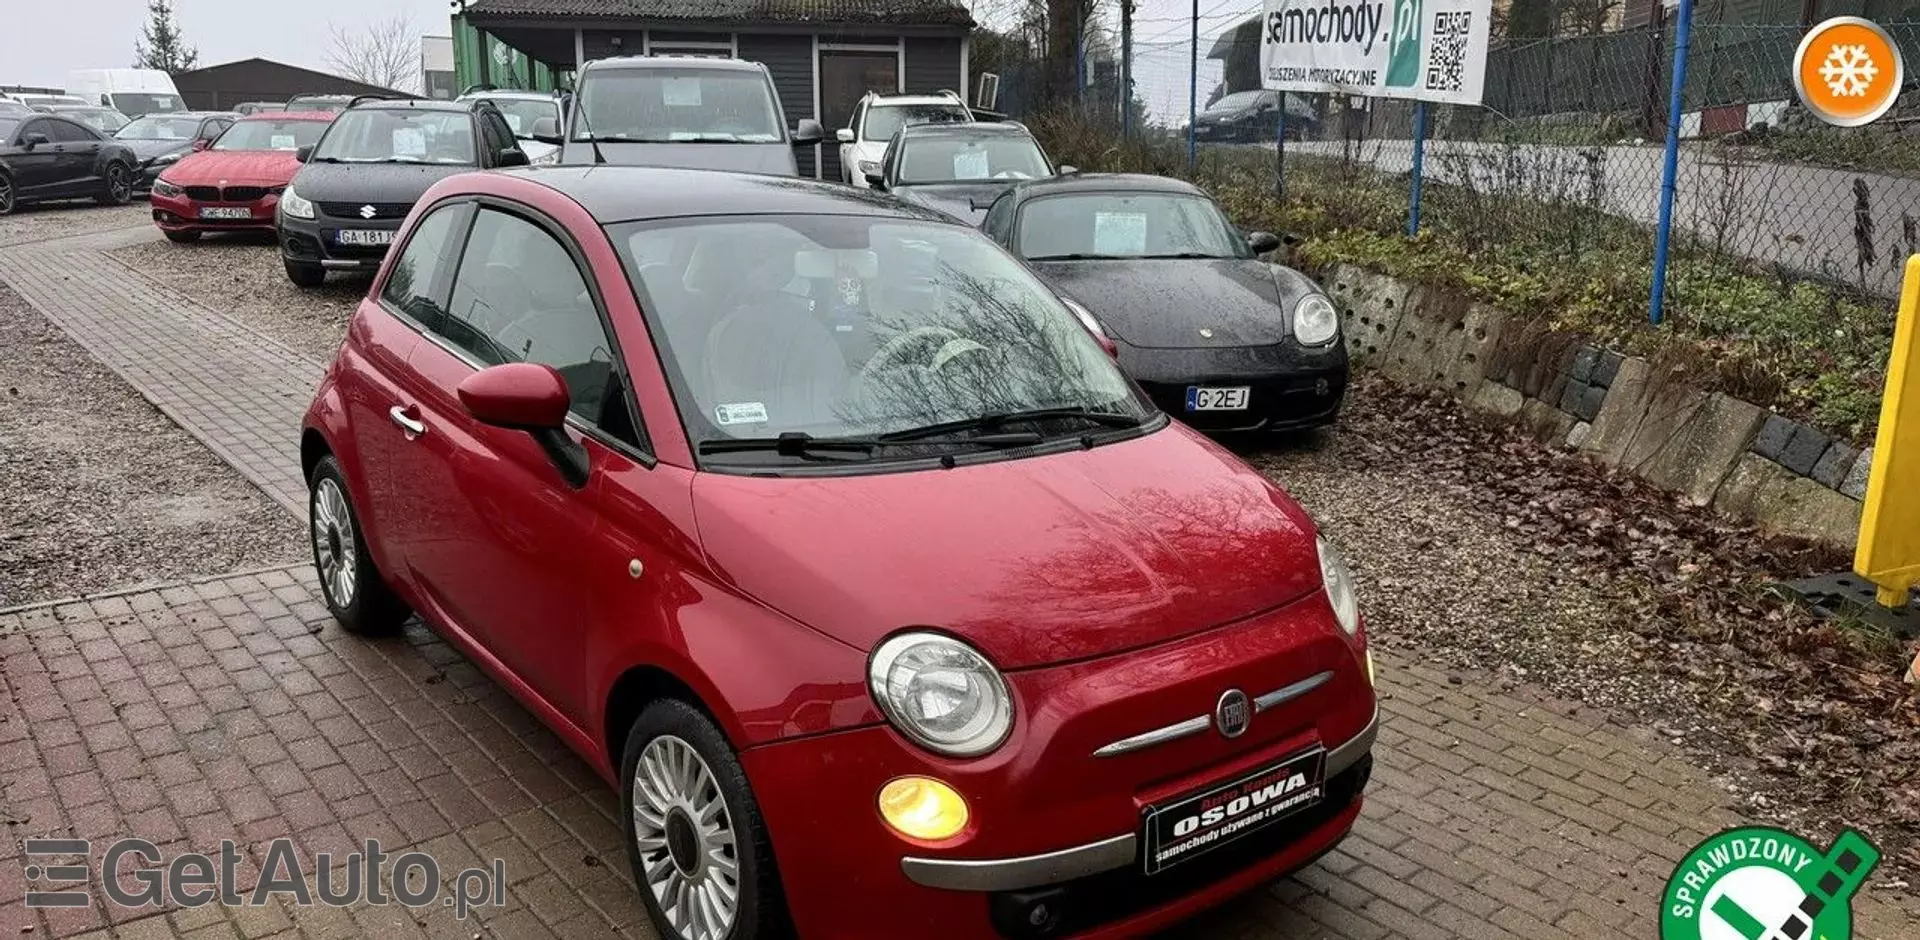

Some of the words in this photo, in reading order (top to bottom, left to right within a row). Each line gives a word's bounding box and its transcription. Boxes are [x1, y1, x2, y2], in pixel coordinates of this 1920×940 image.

[342, 231, 357, 242] GA
[1197, 390, 1209, 408] G
[1213, 390, 1246, 408] 2EJ
[1155, 828, 1219, 862] samochody
[1220, 813, 1264, 837] używane
[1271, 787, 1320, 815] gwarancją
[1173, 772, 1306, 837] OSOWA
